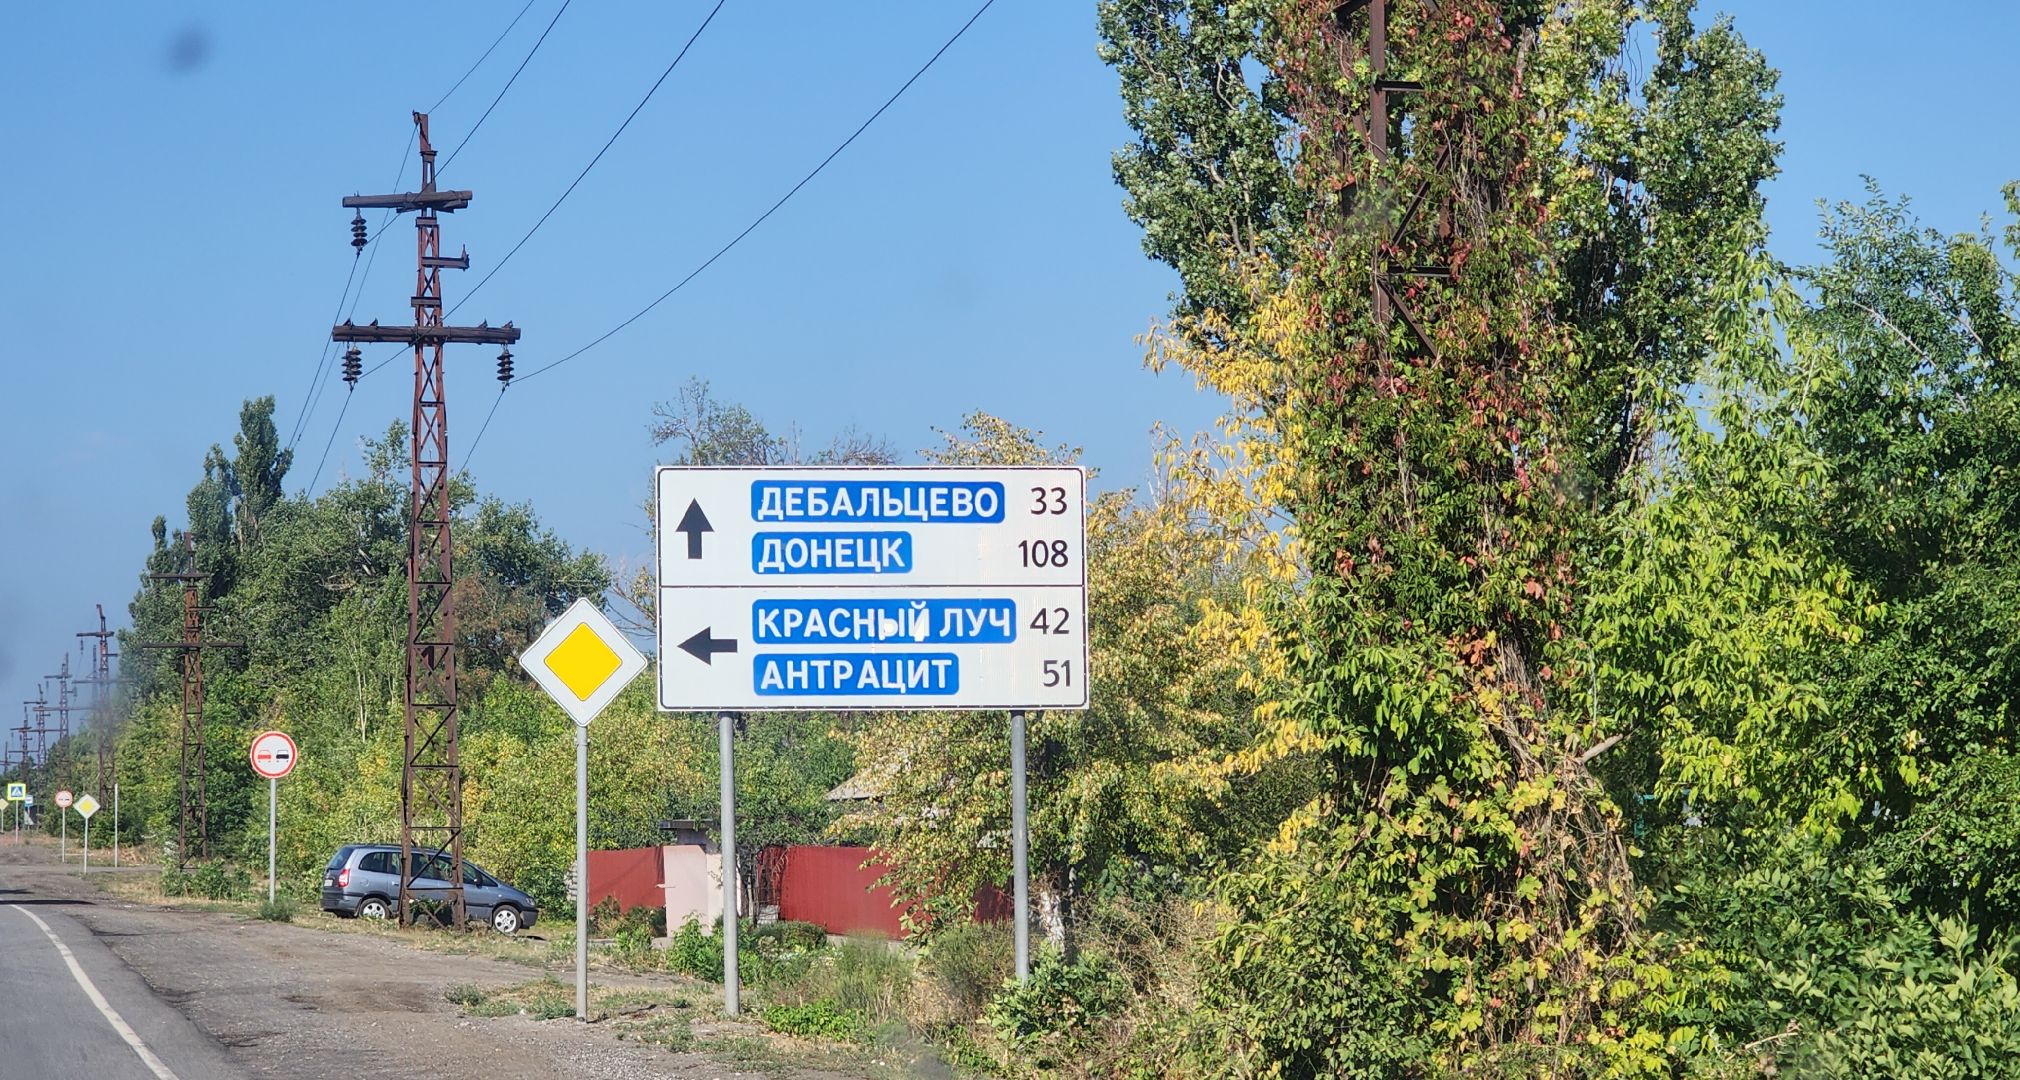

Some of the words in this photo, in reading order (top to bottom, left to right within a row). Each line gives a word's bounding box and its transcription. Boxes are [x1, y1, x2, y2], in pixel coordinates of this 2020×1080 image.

[758, 487, 998, 521] ДЕБАЛЬЦЕВО
[1030, 487, 1068, 515] 33
[758, 539, 905, 572] ДОНЕЦК
[1018, 540, 1069, 568] 108
[758, 600, 930, 641] КРАСНЫЙ
[939, 608, 1011, 637] ЛУЧ
[1030, 607, 1070, 635] 42
[761, 660, 952, 693] АНТРАЦИТ
[1042, 659, 1071, 687] 51
